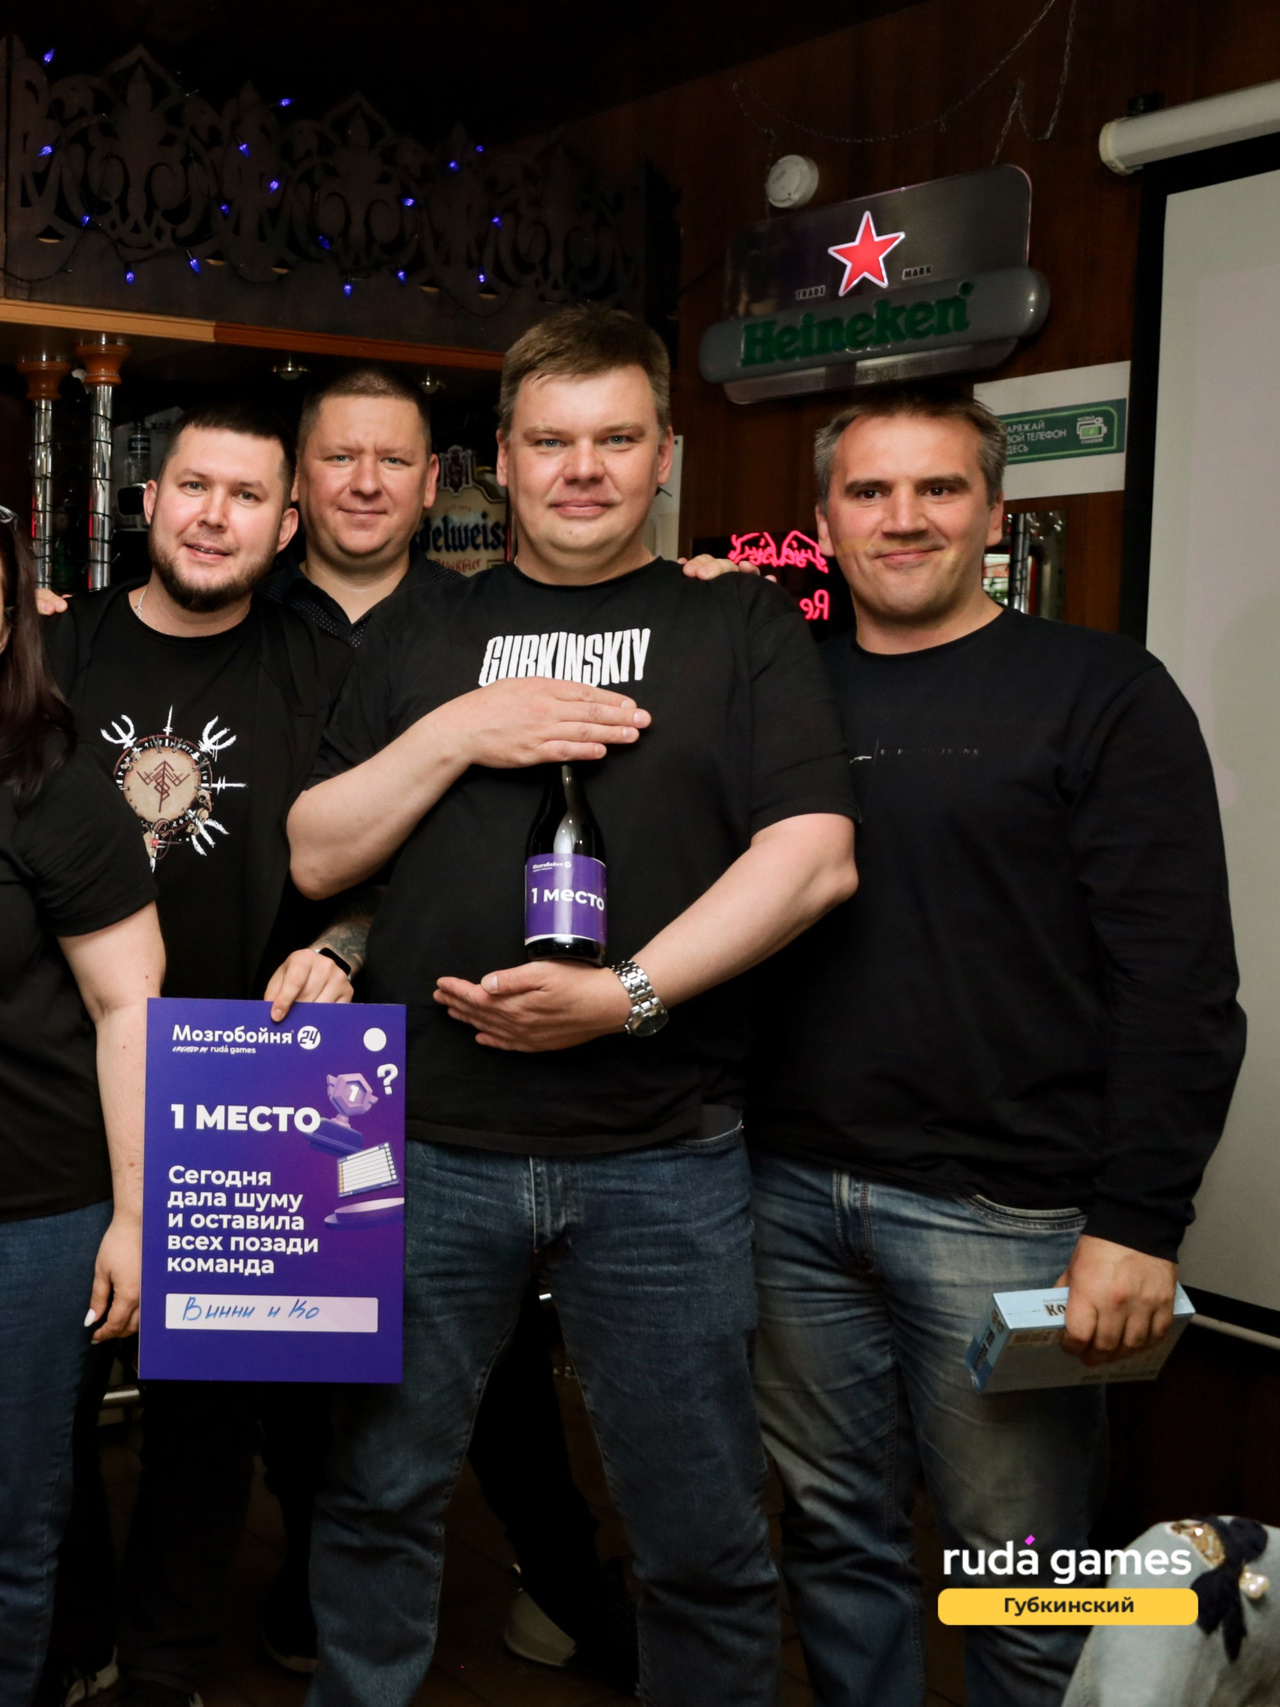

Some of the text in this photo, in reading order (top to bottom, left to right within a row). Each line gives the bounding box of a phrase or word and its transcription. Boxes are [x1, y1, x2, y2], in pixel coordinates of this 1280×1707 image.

[796, 265, 933, 301] TRADE MARK
[740, 296, 970, 368] Heineken
[1006, 420, 1045, 434] АРЯЖАЙ
[1006, 433, 1025, 445] ВОЙ
[1026, 429, 1067, 442] ТЕЛЕФОН
[1006, 443, 1029, 455] ДЕСЬ
[531, 887, 606, 912] 1 место
[172, 1024, 321, 1046] Мозгобойня 24
[230, 1046, 257, 1055] games
[376, 1063, 399, 1096] ?
[348, 1084, 360, 1103] 1
[171, 1103, 321, 1133] 1 МЕСТО
[168, 1165, 272, 1188] Сегодня
[167, 1190, 304, 1211] дала шуму
[168, 1212, 305, 1231] и оставила
[168, 1235, 319, 1255] всех позади
[167, 1257, 275, 1277] команда
[182, 1296, 320, 1321] Винни и Ко
